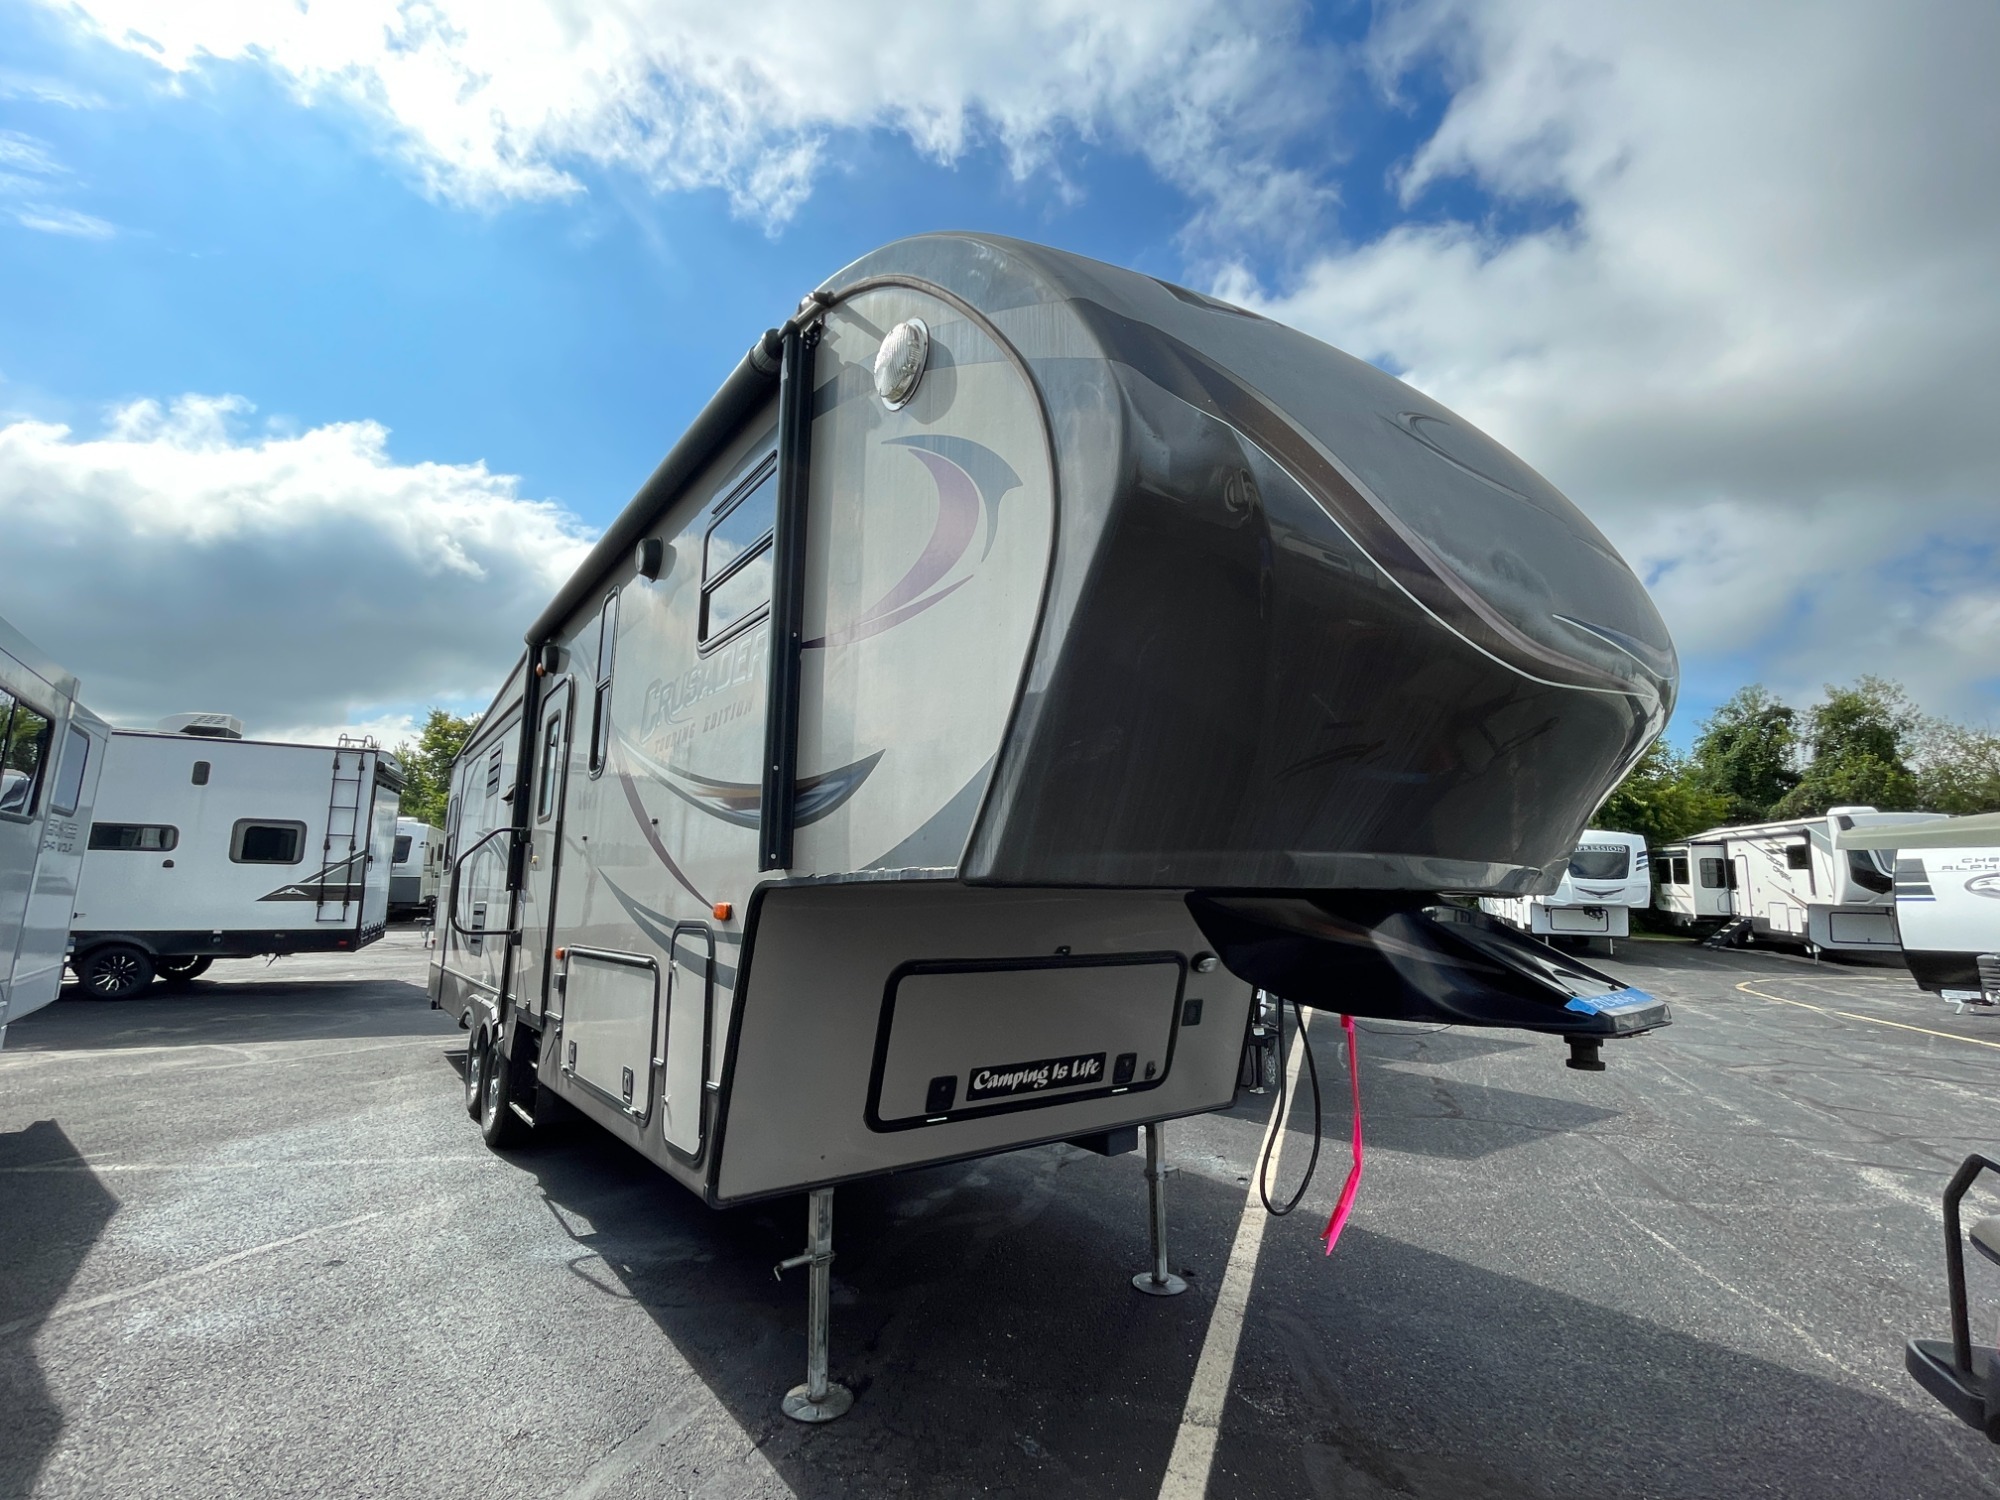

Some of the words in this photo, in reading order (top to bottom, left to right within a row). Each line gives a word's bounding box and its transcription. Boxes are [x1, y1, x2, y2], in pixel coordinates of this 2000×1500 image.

[702, 697, 755, 734] EDITION
[973, 1065, 1050, 1091] Camping
[1051, 1062, 1069, 1080] Is
[1071, 1058, 1100, 1078] Life
